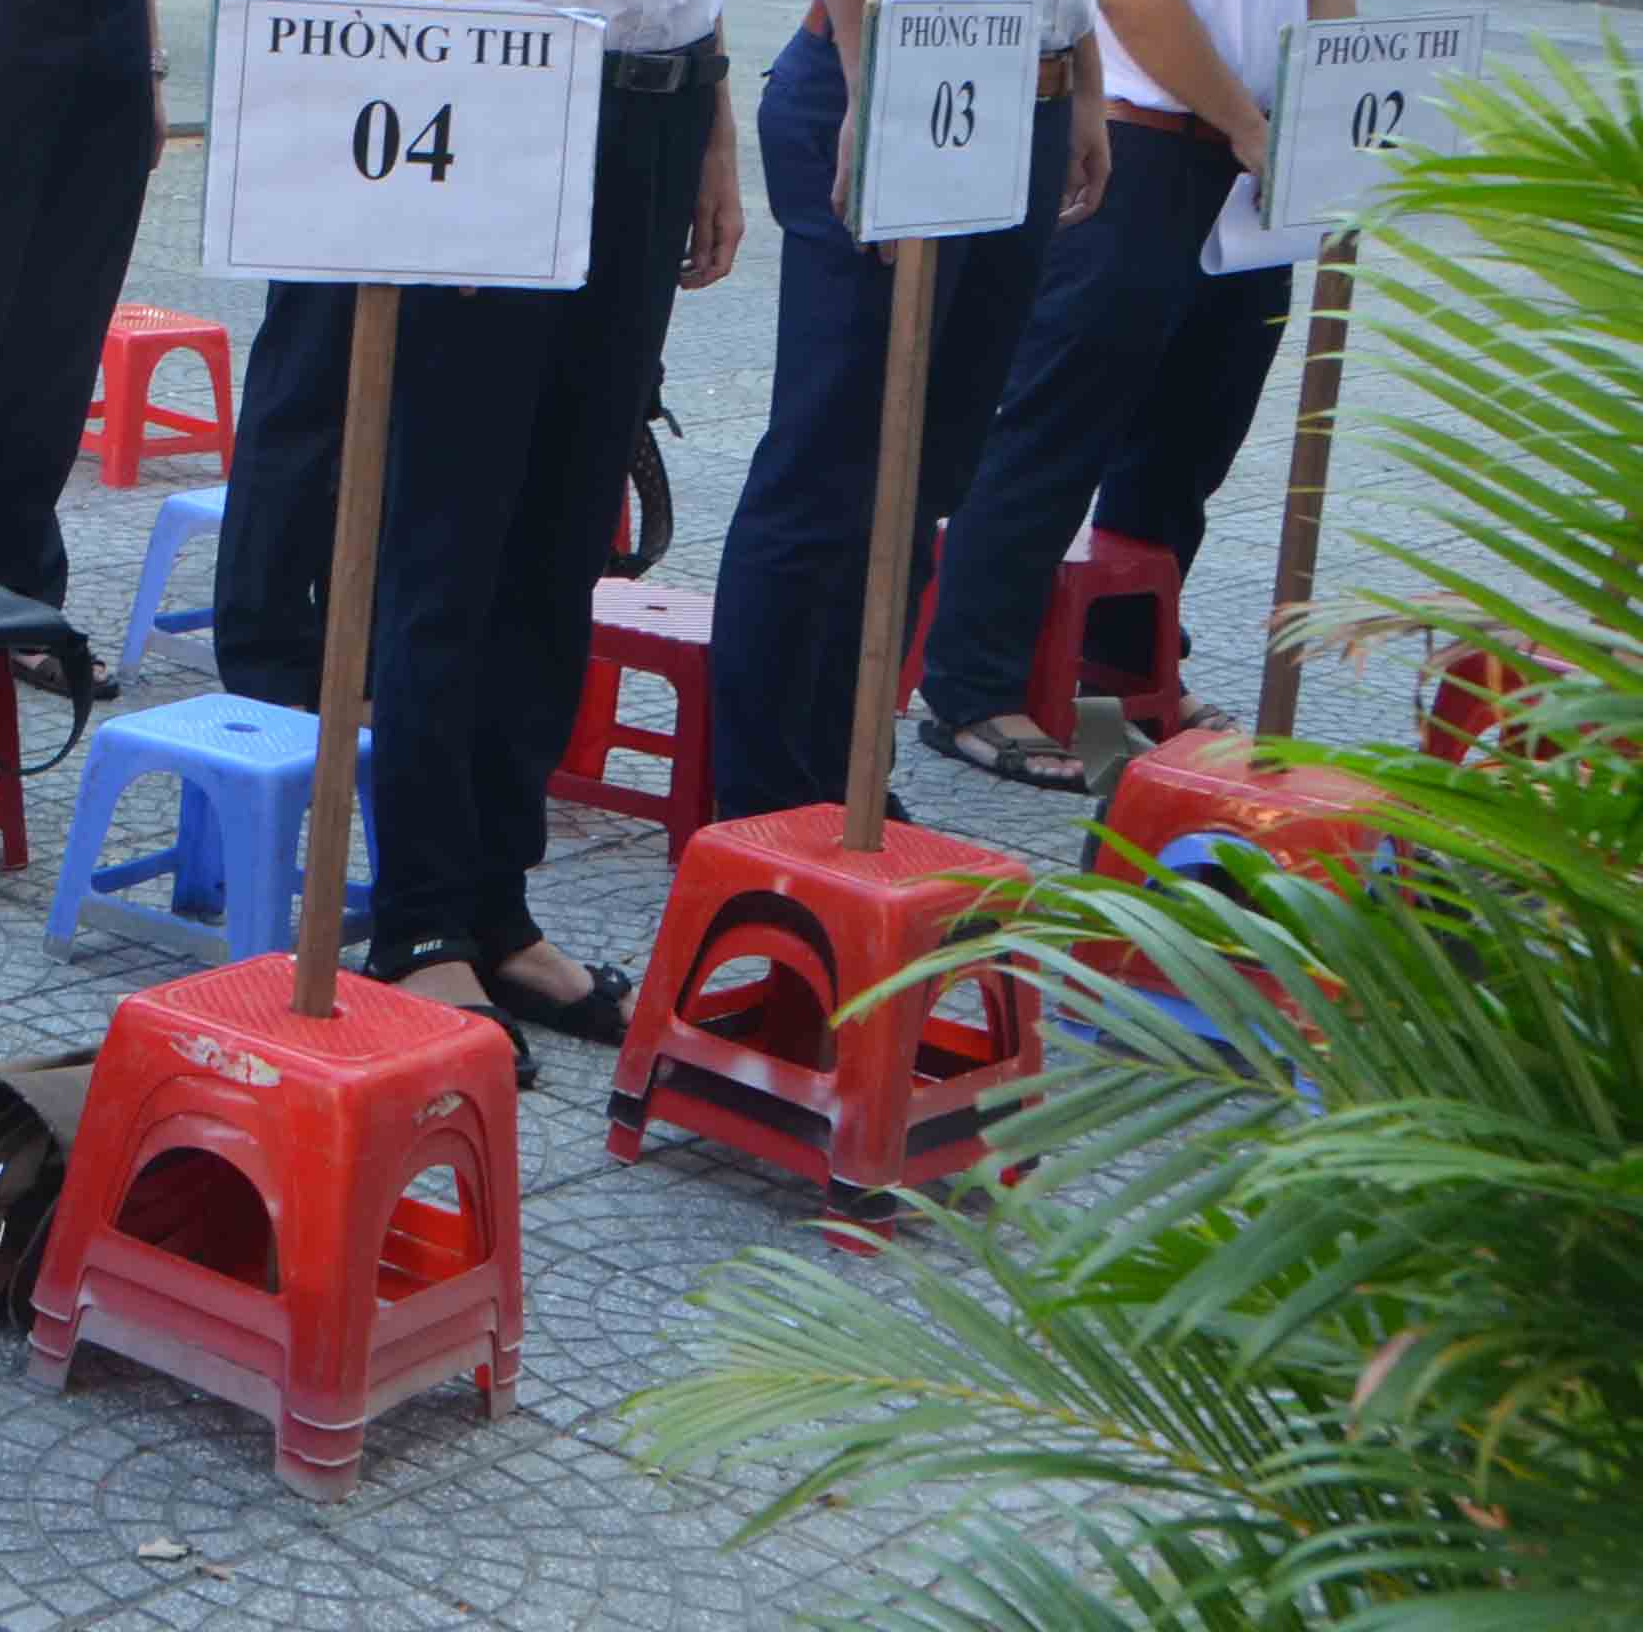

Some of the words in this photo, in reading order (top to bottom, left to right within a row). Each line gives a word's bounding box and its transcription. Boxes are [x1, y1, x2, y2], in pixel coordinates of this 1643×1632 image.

[268, 9, 452, 63] PHÒNG
[466, 27, 556, 68] THI
[899, 6, 979, 48] PHÒNG
[986, 15, 1022, 47] THI
[1315, 26, 1410, 66] PHÒNG
[1414, 29, 1460, 60] THI
[352, 99, 455, 182] 04
[930, 80, 976, 149] 03
[1351, 90, 1405, 150] 02
